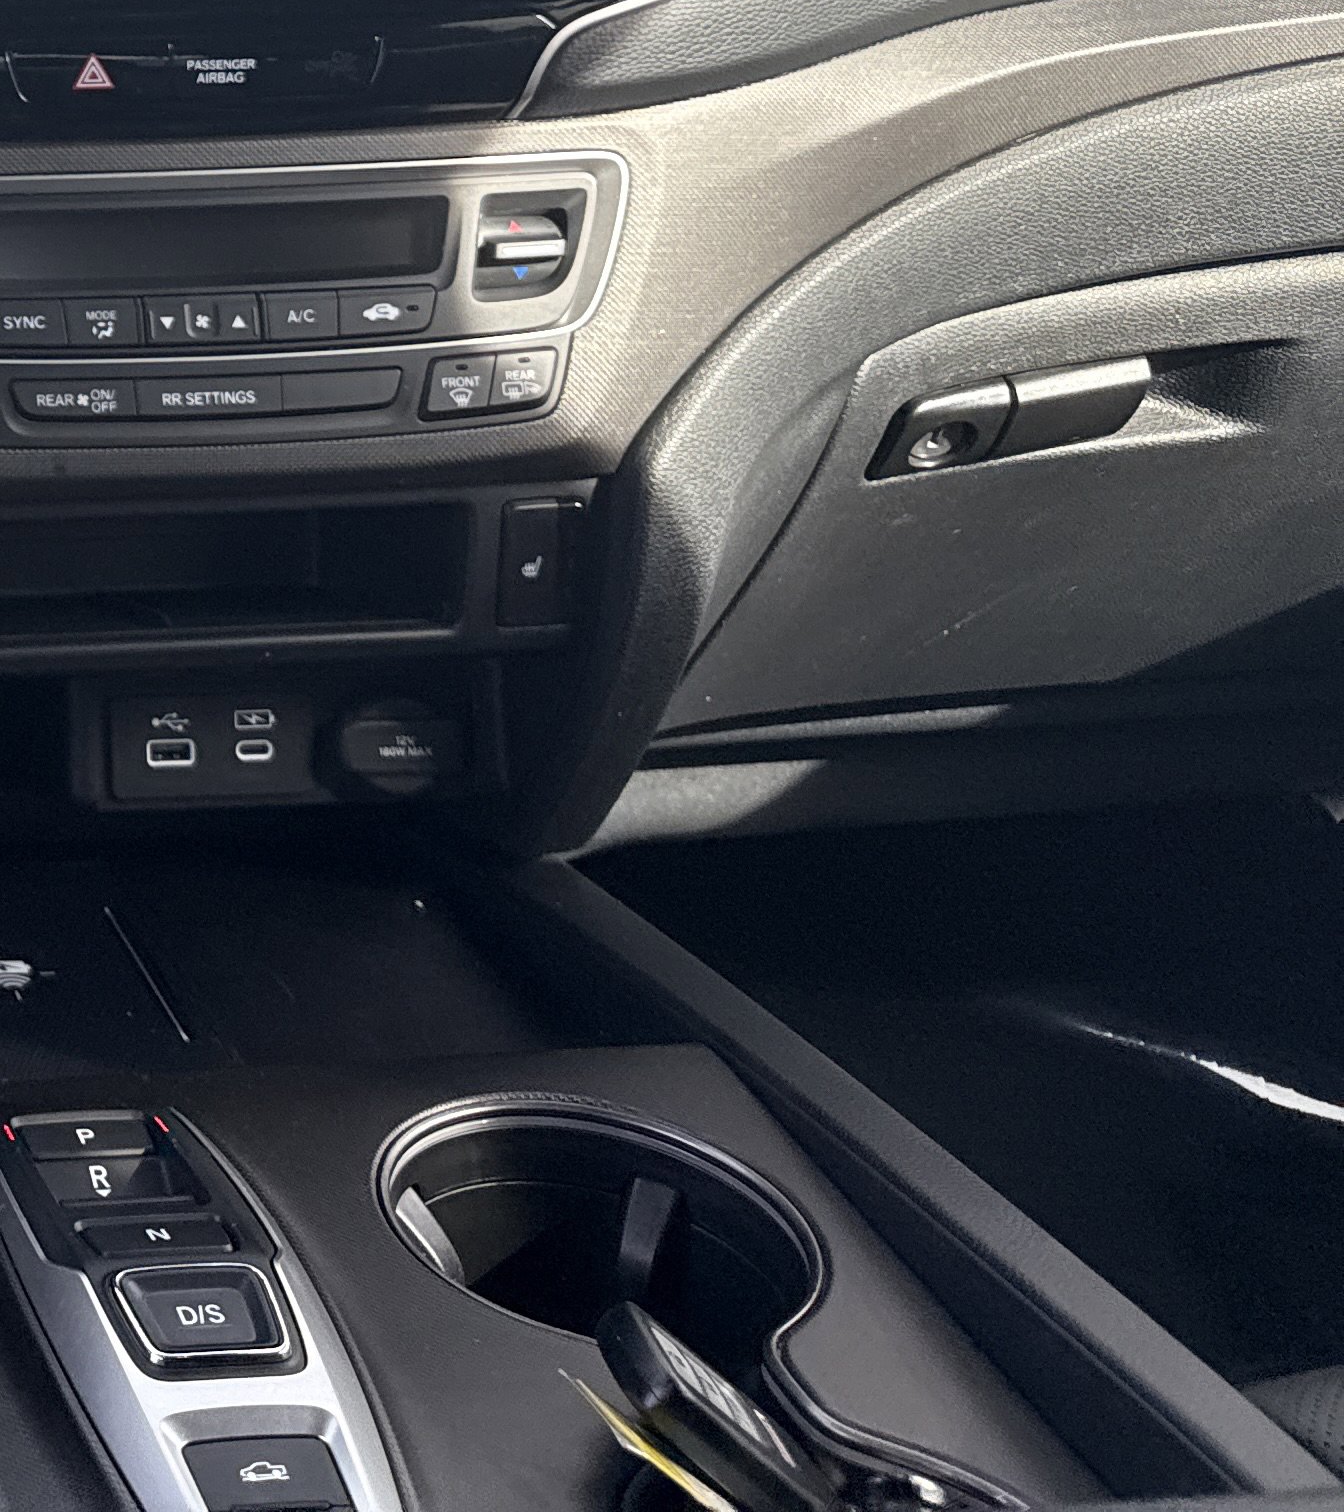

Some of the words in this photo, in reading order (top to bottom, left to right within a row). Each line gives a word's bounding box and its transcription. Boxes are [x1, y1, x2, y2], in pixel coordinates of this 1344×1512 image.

[186, 58, 256, 71] PASSENGER
[196, 71, 245, 84] AIRBAG
[85, 309, 118, 321] MODE
[286, 308, 316, 326] A/C
[3, 315, 47, 330] SYNC
[504, 367, 536, 381] REAR
[440, 374, 481, 389] FRONT
[36, 393, 75, 407] REAR
[161, 392, 183, 405] RR
[185, 390, 256, 406] SETTINGS
[91, 401, 118, 414] OFF
[76, 1128, 95, 1145] P
[88, 1164, 112, 1189] R
[146, 1227, 171, 1241] N
[175, 1304, 226, 1326] D/S
